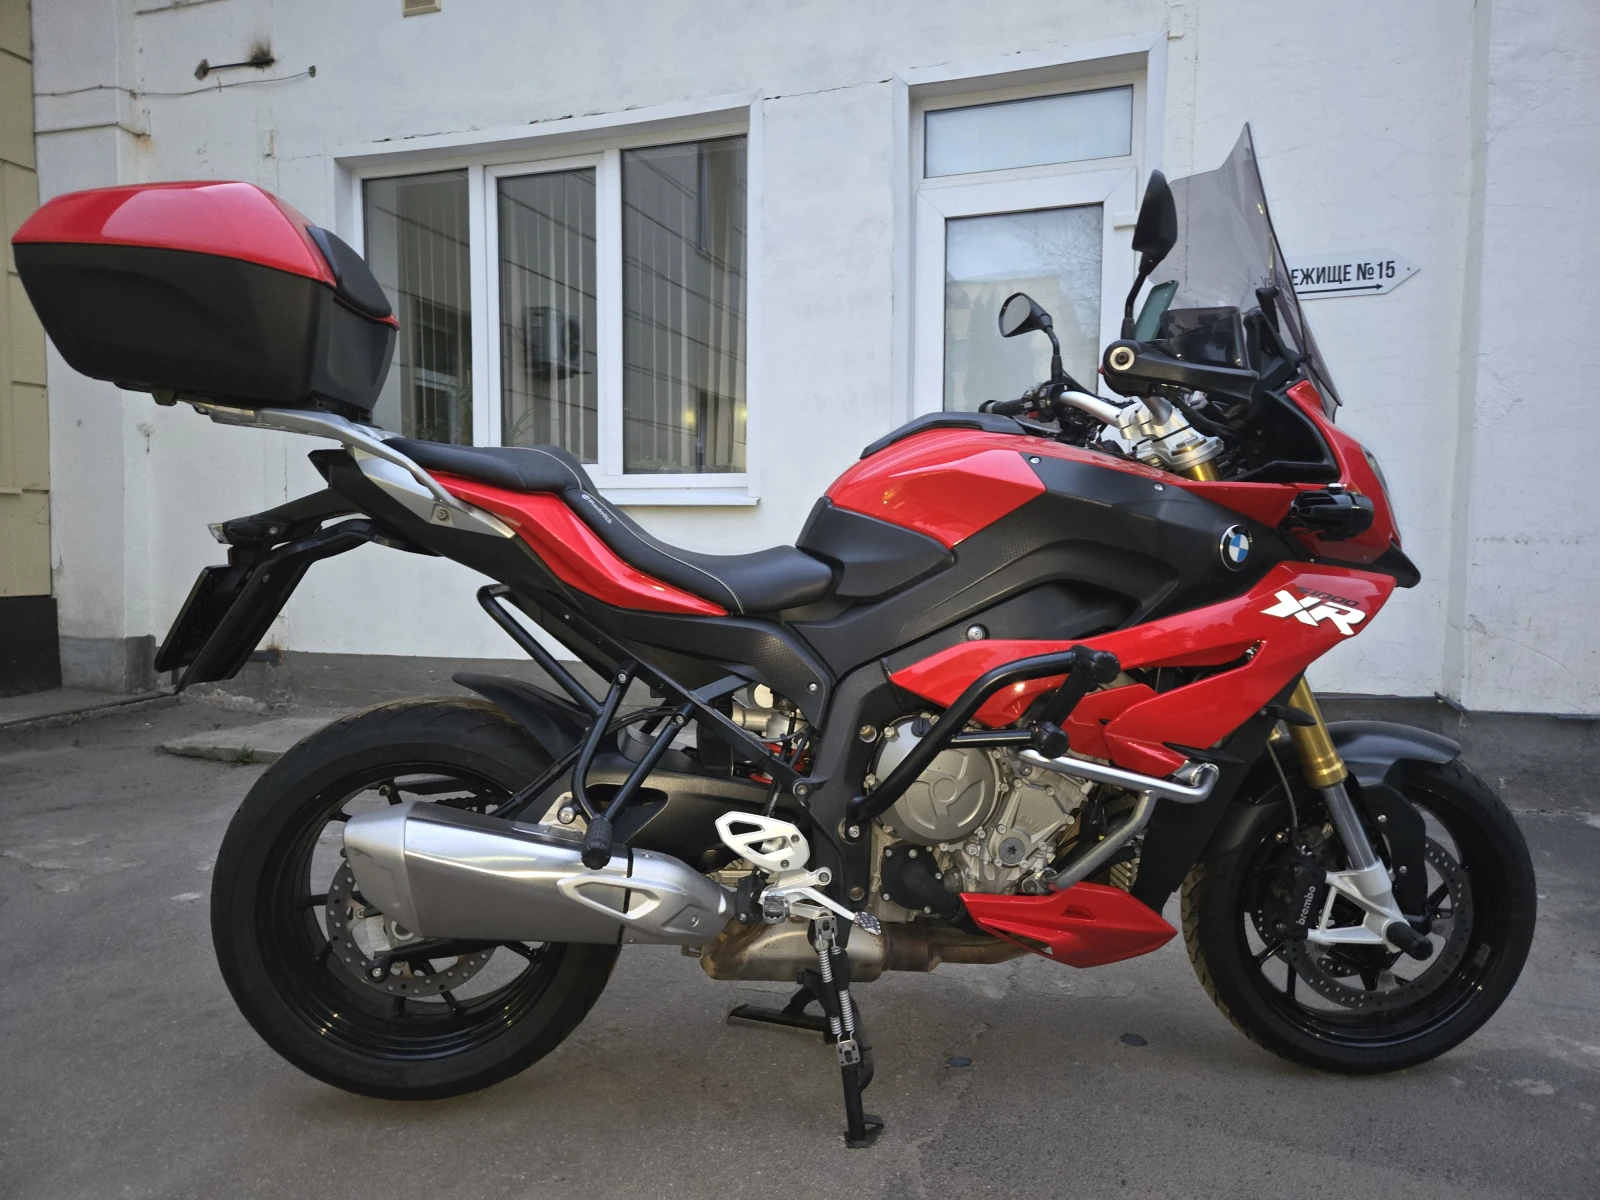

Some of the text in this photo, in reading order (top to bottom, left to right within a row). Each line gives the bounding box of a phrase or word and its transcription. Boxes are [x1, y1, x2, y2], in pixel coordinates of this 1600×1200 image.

[1290, 264, 1352, 285] ЕЖИЩЕ
[1377, 260, 1395, 279] 15
[1260, 590, 1367, 635] XR
[1296, 885, 1316, 925] brembo
